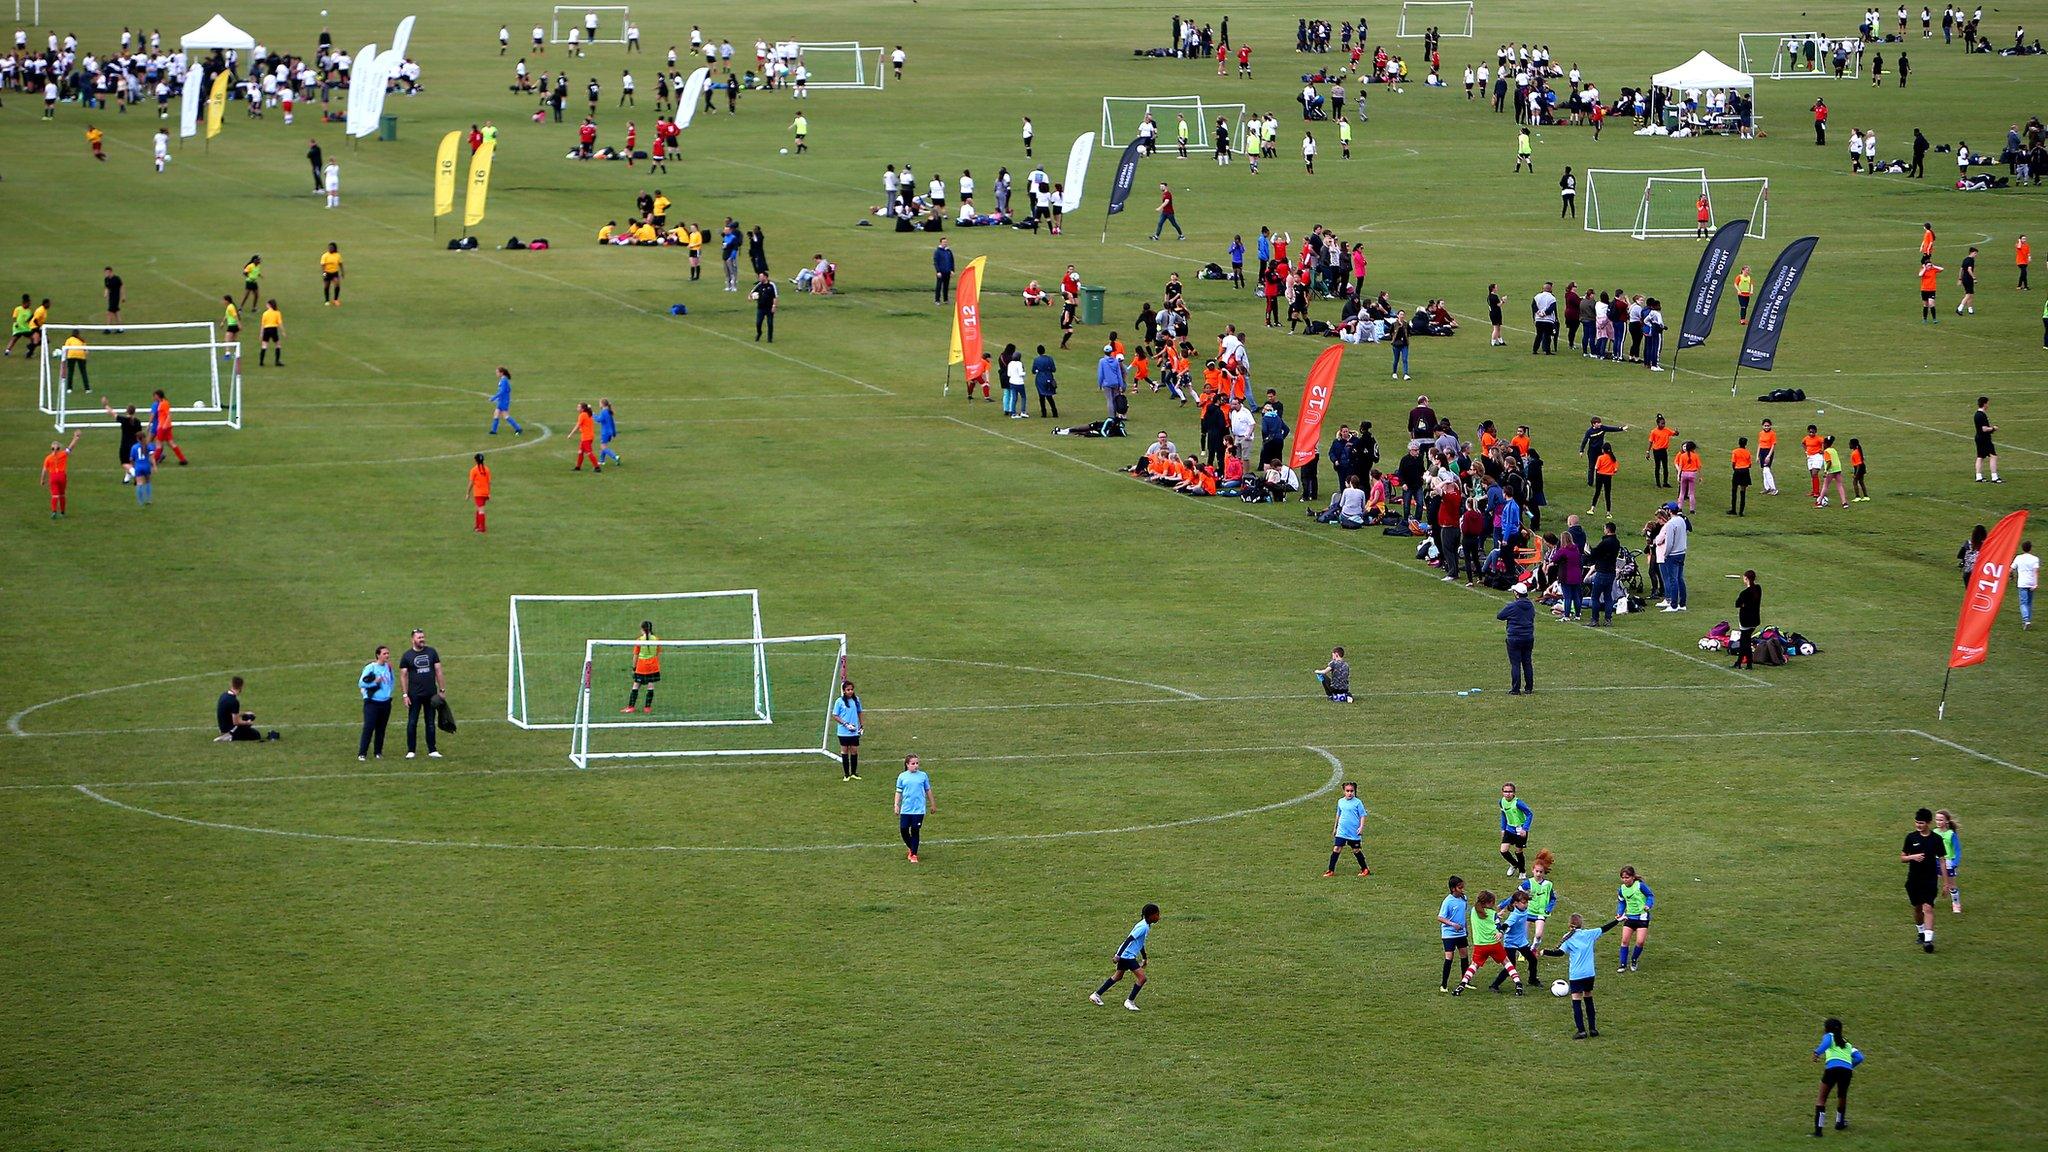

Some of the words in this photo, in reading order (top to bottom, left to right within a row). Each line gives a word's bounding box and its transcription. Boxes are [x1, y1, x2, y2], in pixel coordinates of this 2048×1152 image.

[442, 160, 452, 176] 16
[474, 169, 485, 185] 16
[1702, 279, 1718, 316] MEETING
[1716, 250, 1730, 276] POINT
[1705, 248, 1721, 283] COACHING
[1770, 265, 1789, 300] COACHING
[1767, 295, 1784, 332] MEETING
[1781, 266, 1798, 292] POINT
[963, 305, 977, 341] U12
[1304, 385, 1327, 425] U12
[1972, 561, 2004, 612] U12
